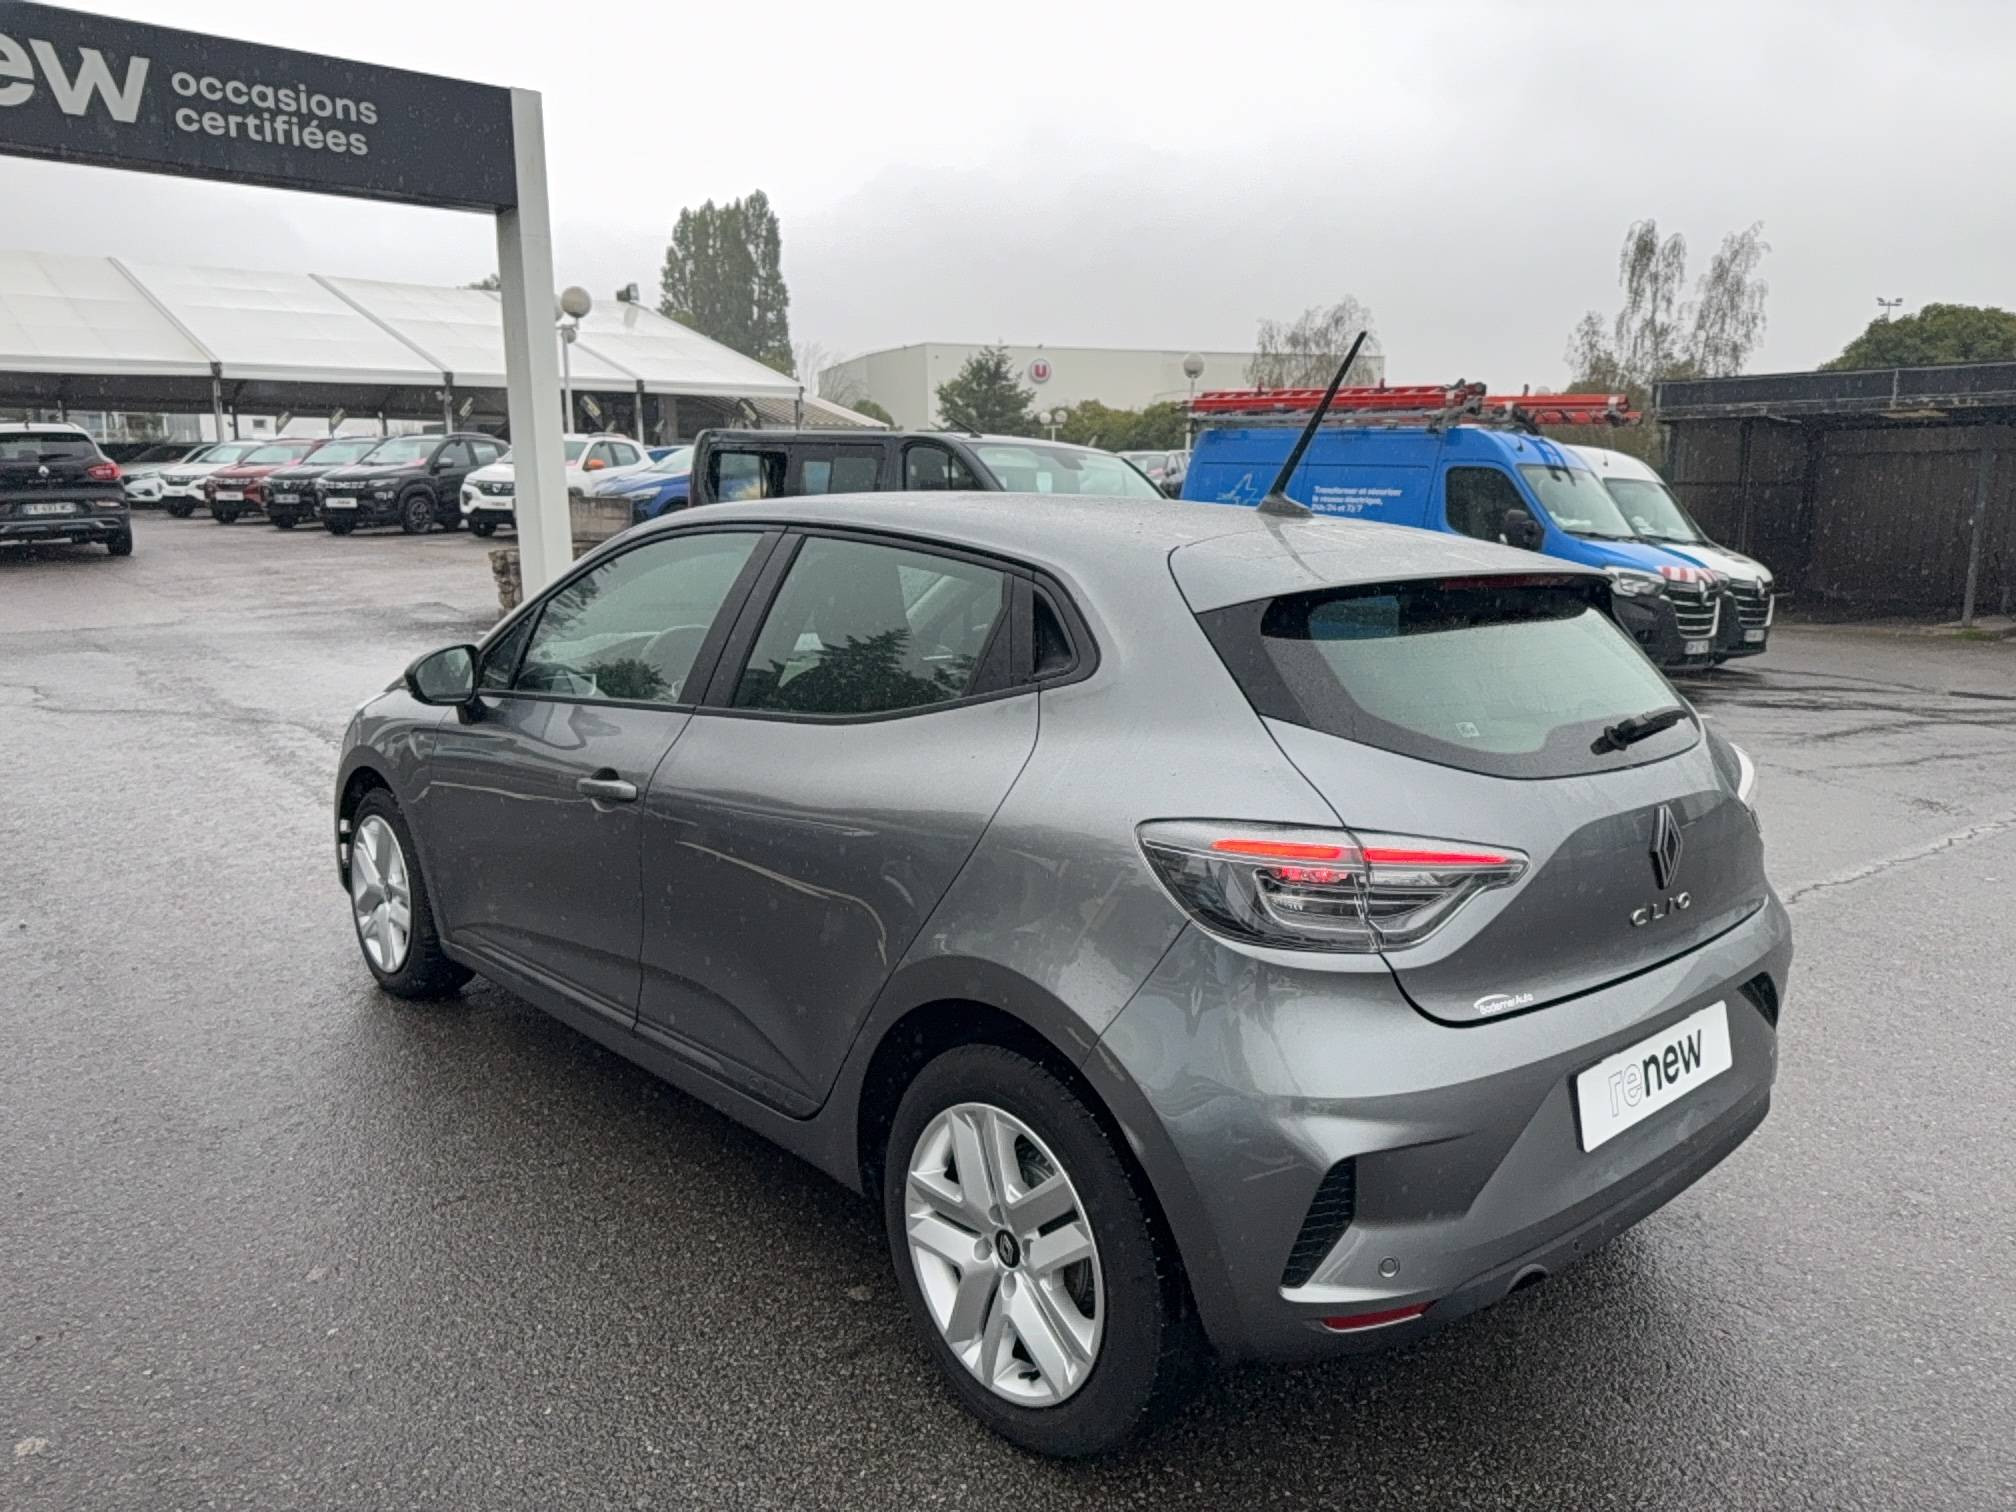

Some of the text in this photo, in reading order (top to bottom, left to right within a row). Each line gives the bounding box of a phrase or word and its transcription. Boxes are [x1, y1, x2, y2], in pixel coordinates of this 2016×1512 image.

[171, 72, 378, 124] occasions
[175, 107, 368, 155] certifiées
[1034, 363, 1047, 378] U
[1631, 892, 1690, 926] CLIO
[1608, 1029, 1701, 1118] renew
